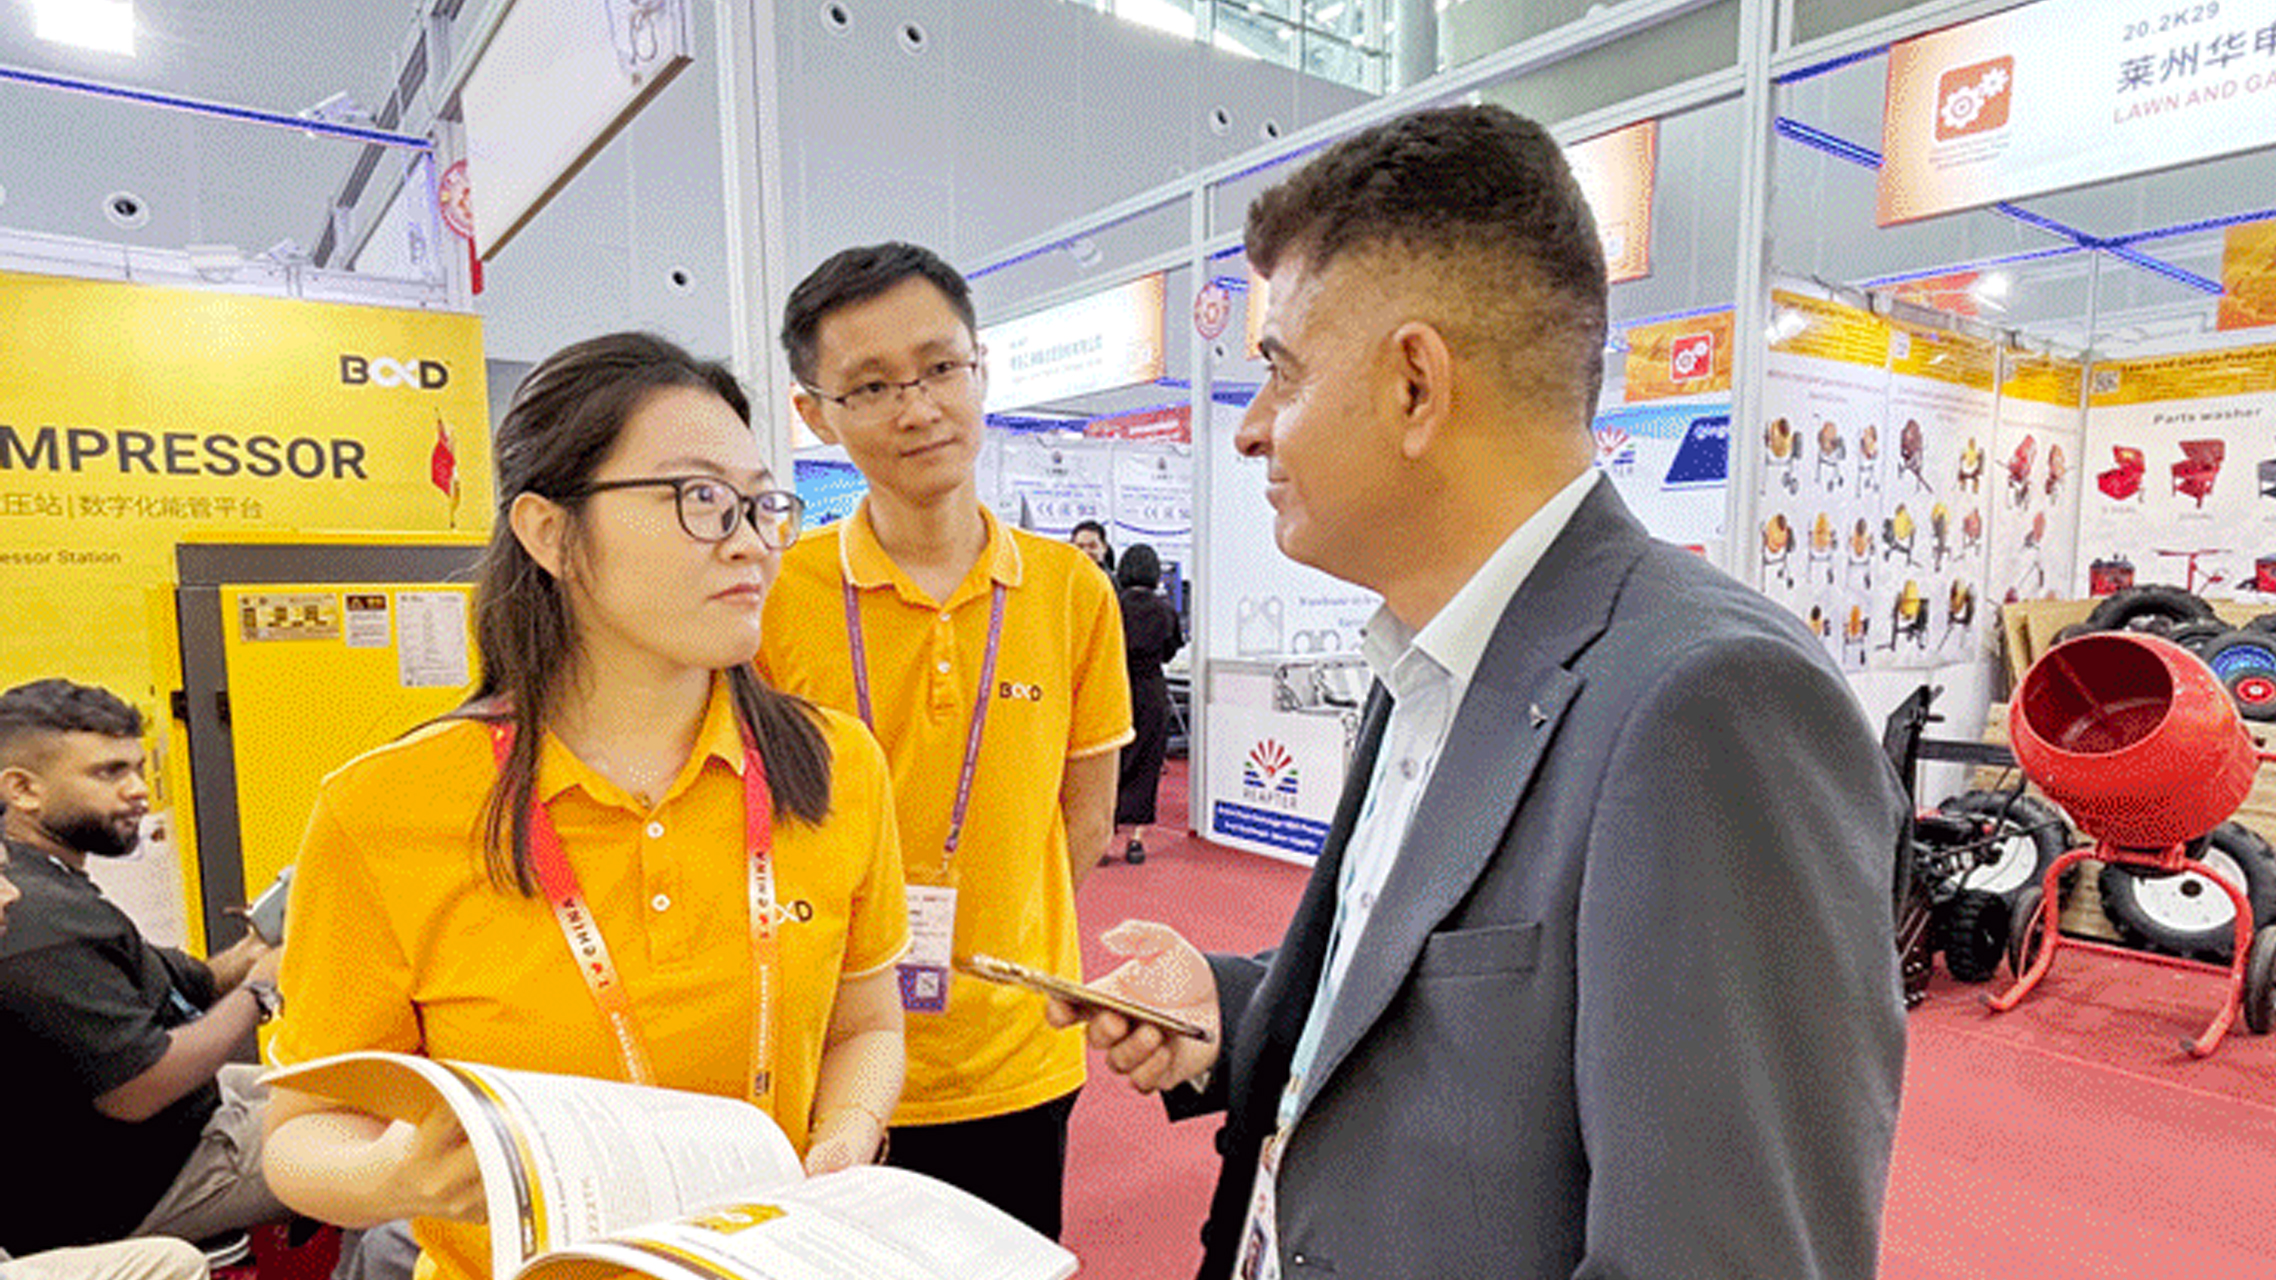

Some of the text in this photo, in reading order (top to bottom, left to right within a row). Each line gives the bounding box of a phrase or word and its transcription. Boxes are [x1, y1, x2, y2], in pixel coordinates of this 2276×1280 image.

[2122, 1, 2221, 42] 20.2K29
[2112, 93, 2180, 124] LAWN
[2184, 79, 2238, 107] AND
[2153, 406, 2263, 425] Parts washer
[56, 550, 122, 565] Station
